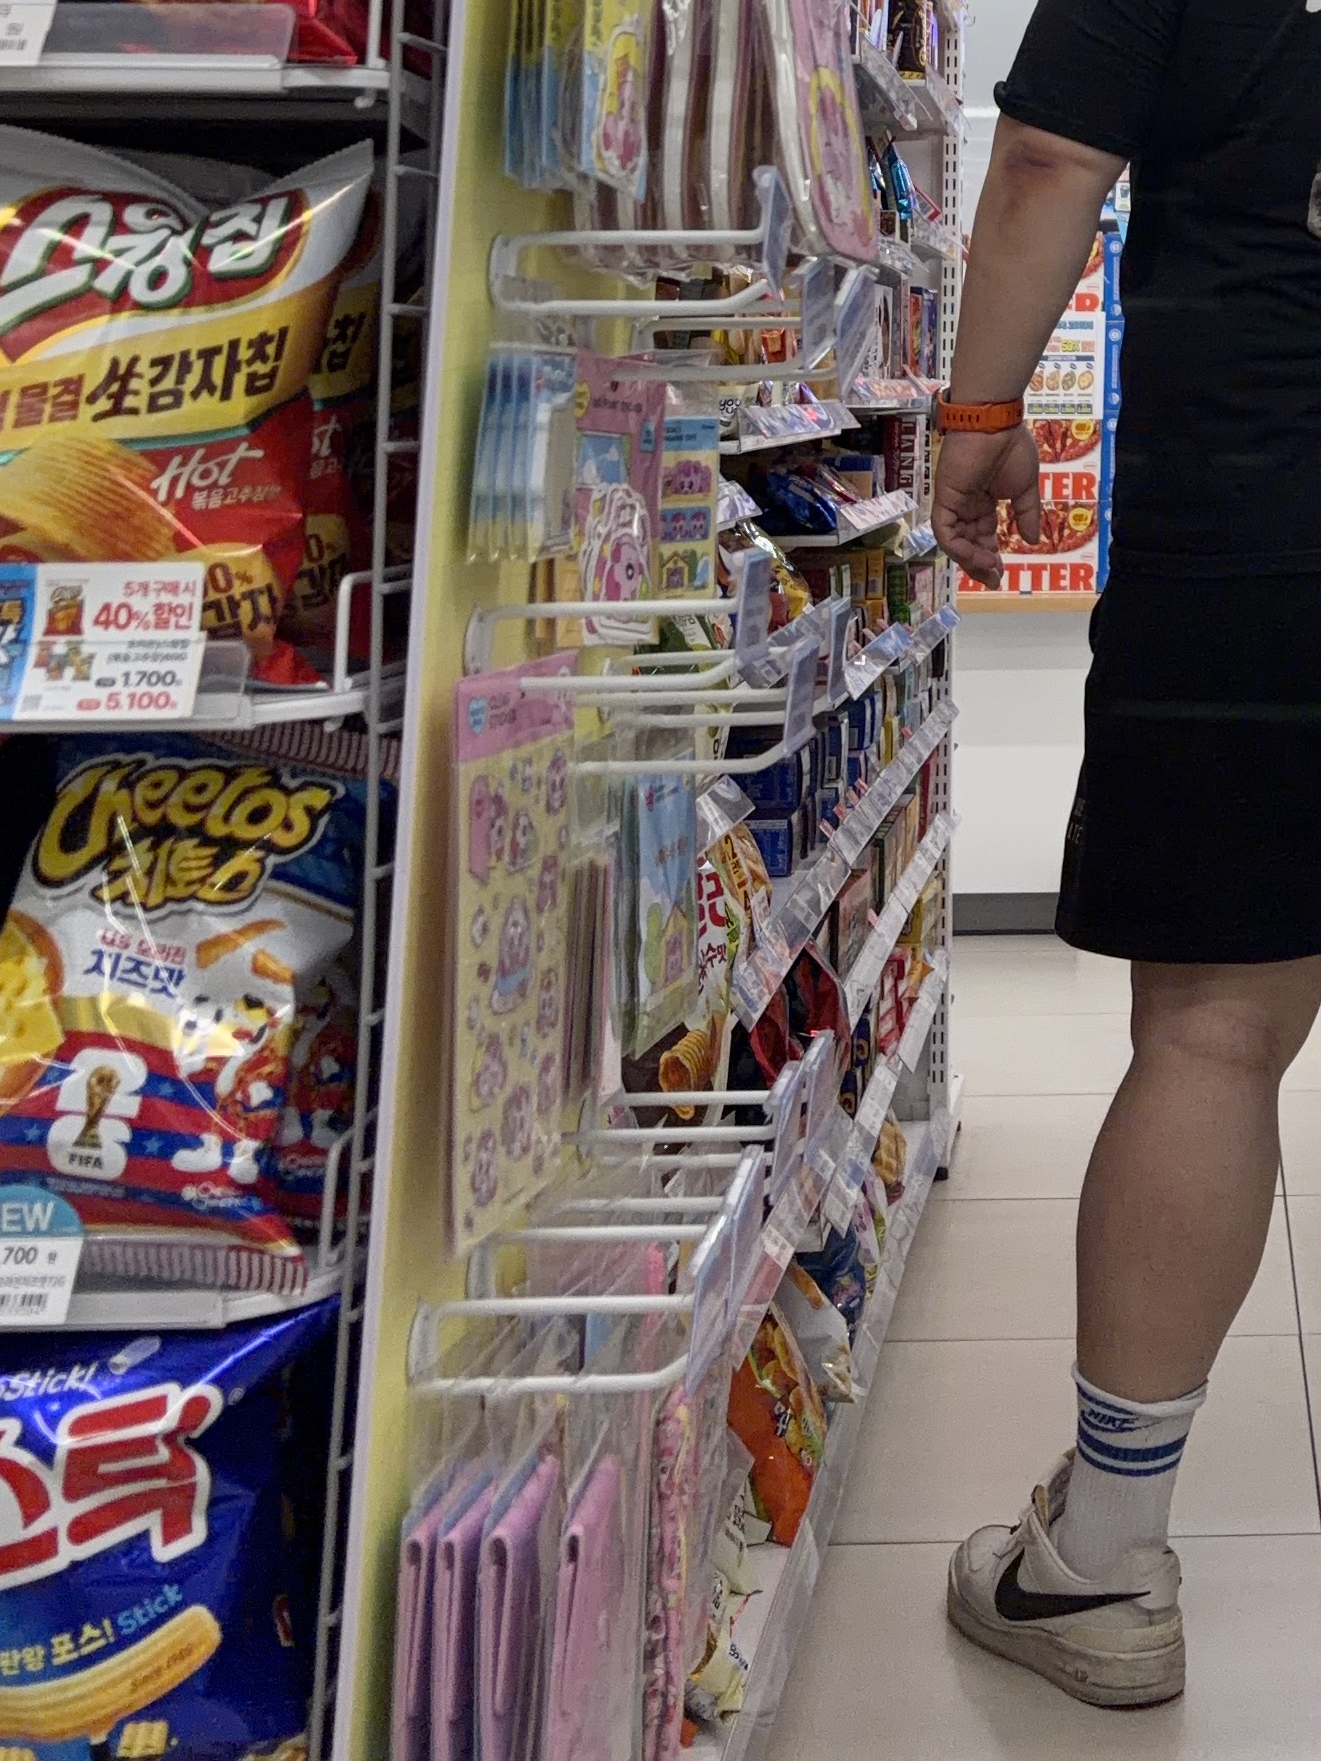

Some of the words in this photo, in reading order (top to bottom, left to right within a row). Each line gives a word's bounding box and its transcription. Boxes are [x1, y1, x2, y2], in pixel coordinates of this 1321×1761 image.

[12, 374, 85, 429] 물결
[151, 443, 266, 504] Hot
[1039, 472, 1097, 500] TER
[957, 563, 1095, 592] TTER
[94, 602, 150, 631] 40%
[152, 601, 194, 630] 할인
[37, 762, 337, 883] Cheetos
[84, 947, 187, 999] 치즈맛
[1, 1200, 55, 1233] EW
[2, 1246, 39, 1265] 700
[0, 1364, 99, 1398] Stick!
[1088, 1408, 1136, 1429] NIKE
[116, 1583, 184, 1636] Stick
